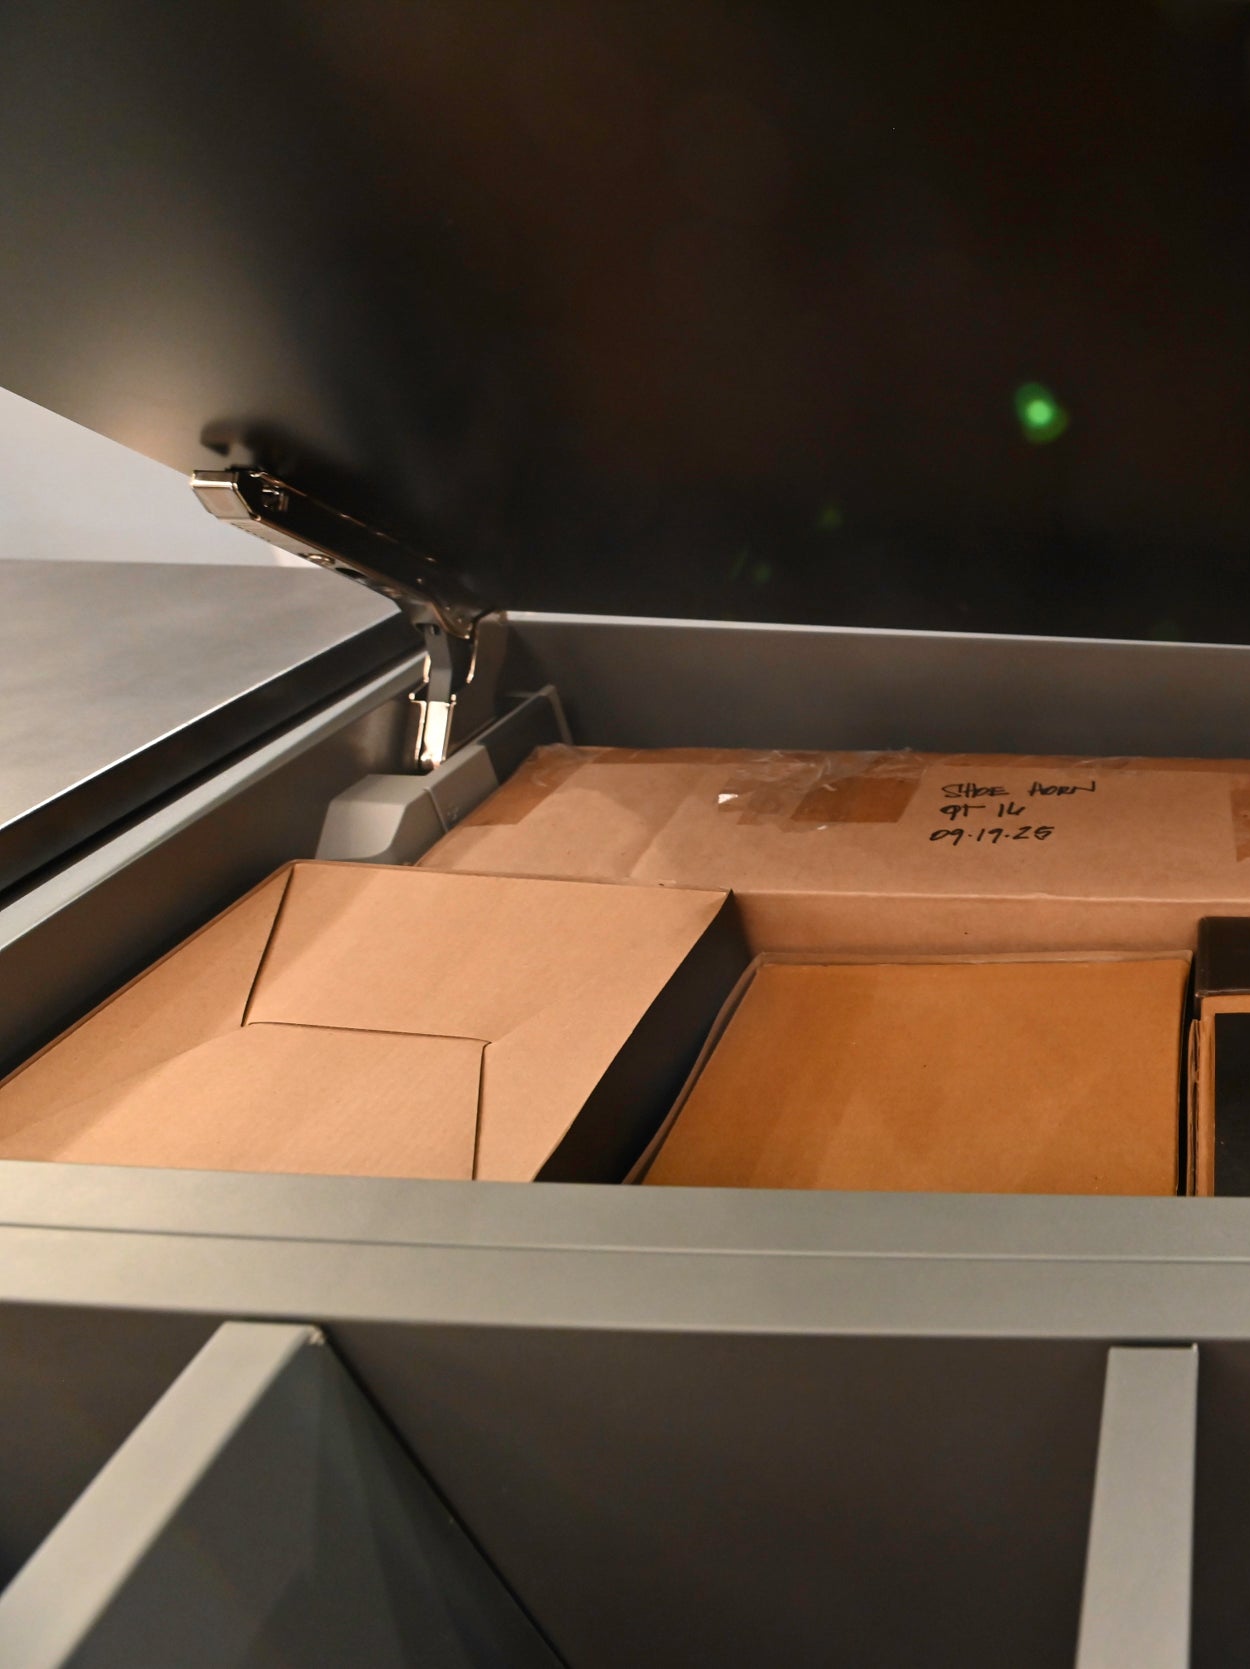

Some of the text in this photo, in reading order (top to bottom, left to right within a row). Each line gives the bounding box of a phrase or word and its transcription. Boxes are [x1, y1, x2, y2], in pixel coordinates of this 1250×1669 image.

[941, 781, 1096, 798] SHOE HORN
[997, 802, 1026, 818] 16
